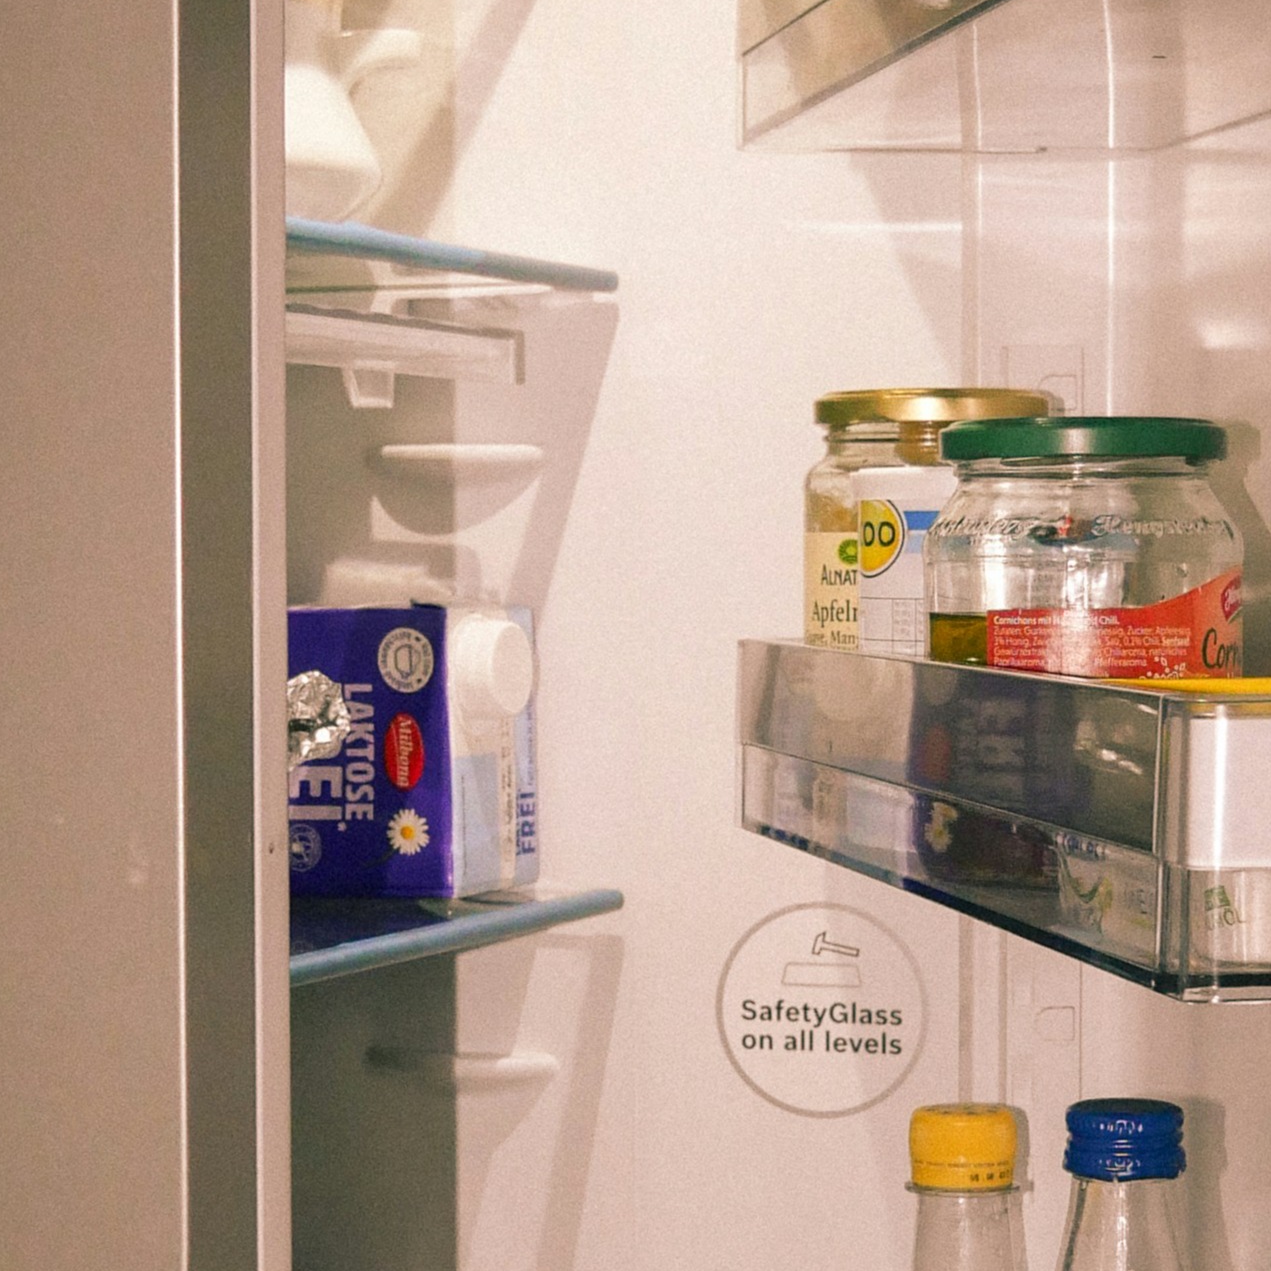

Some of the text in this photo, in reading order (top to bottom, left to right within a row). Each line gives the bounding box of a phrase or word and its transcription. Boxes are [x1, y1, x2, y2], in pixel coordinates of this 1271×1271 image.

[993, 615, 1036, 625] Cornichons
[830, 630, 859, 645] Man
[344, 683, 375, 821] LAKTOSE
[521, 791, 536, 855] FREI
[741, 999, 903, 1028] SafetyGlass
[742, 1030, 902, 1055] on all levels
